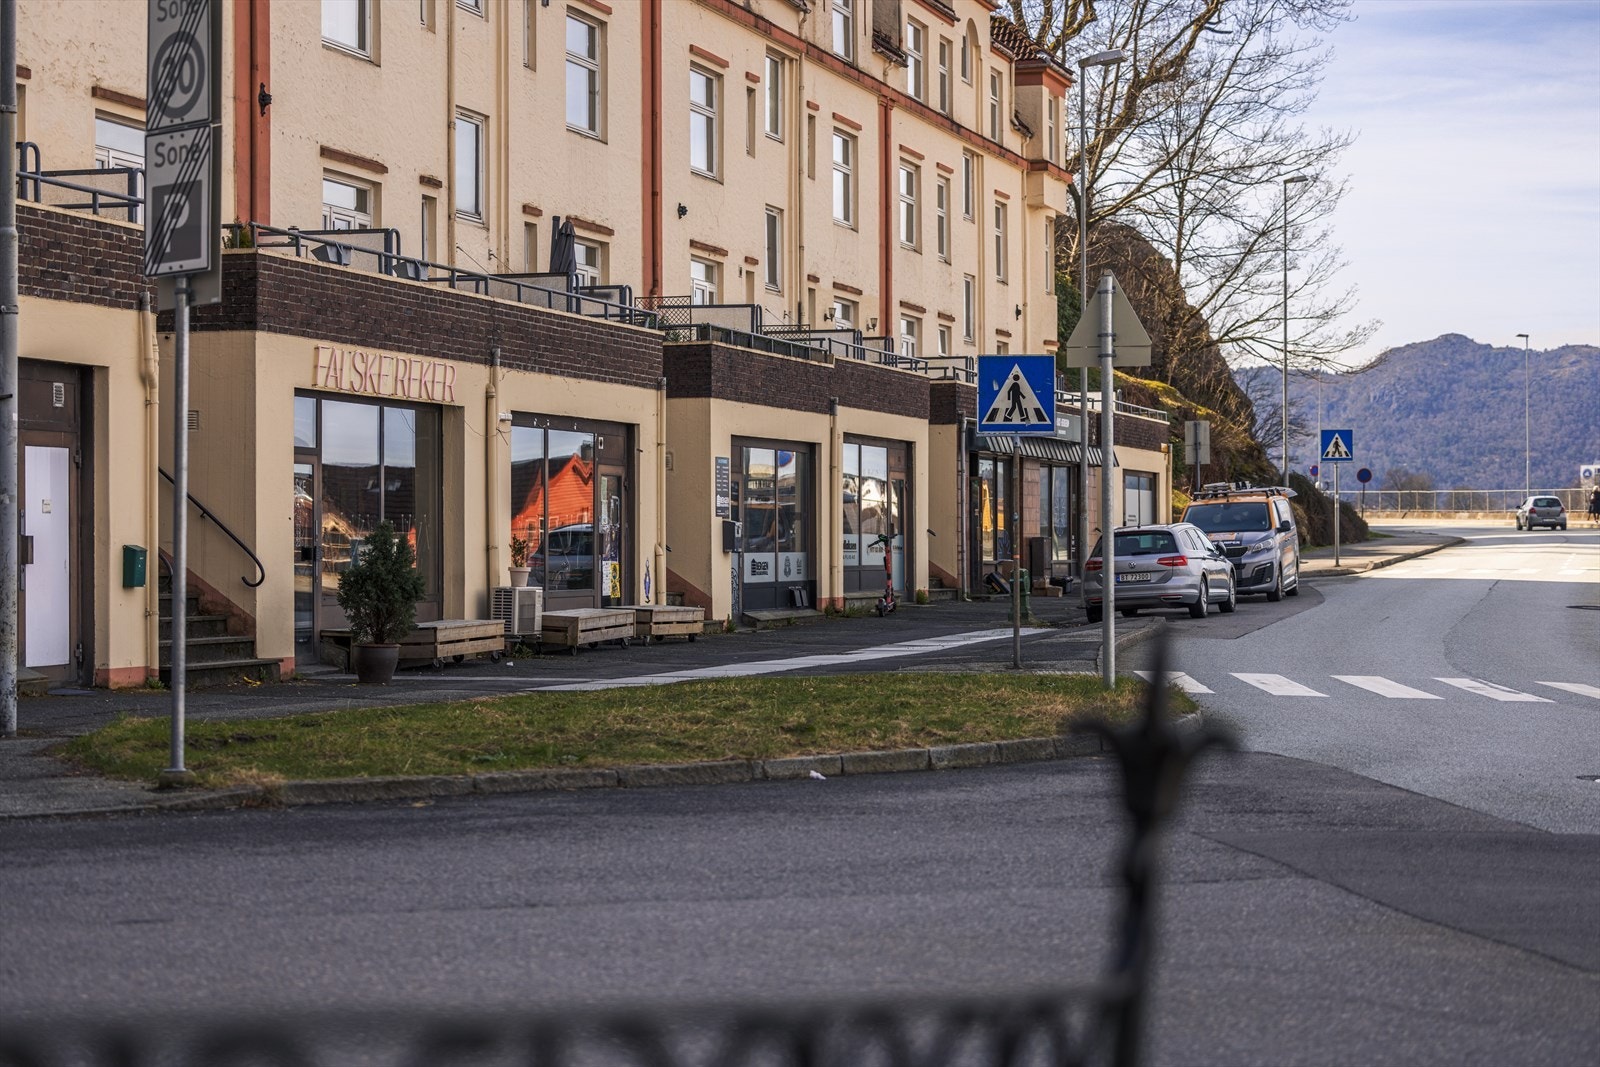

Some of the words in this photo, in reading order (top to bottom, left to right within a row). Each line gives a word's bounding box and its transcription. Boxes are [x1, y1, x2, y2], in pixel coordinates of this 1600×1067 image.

[154, 141, 200, 168] Sone
[315, 345, 394, 396] FALSKE
[395, 356, 457, 402] REKER
